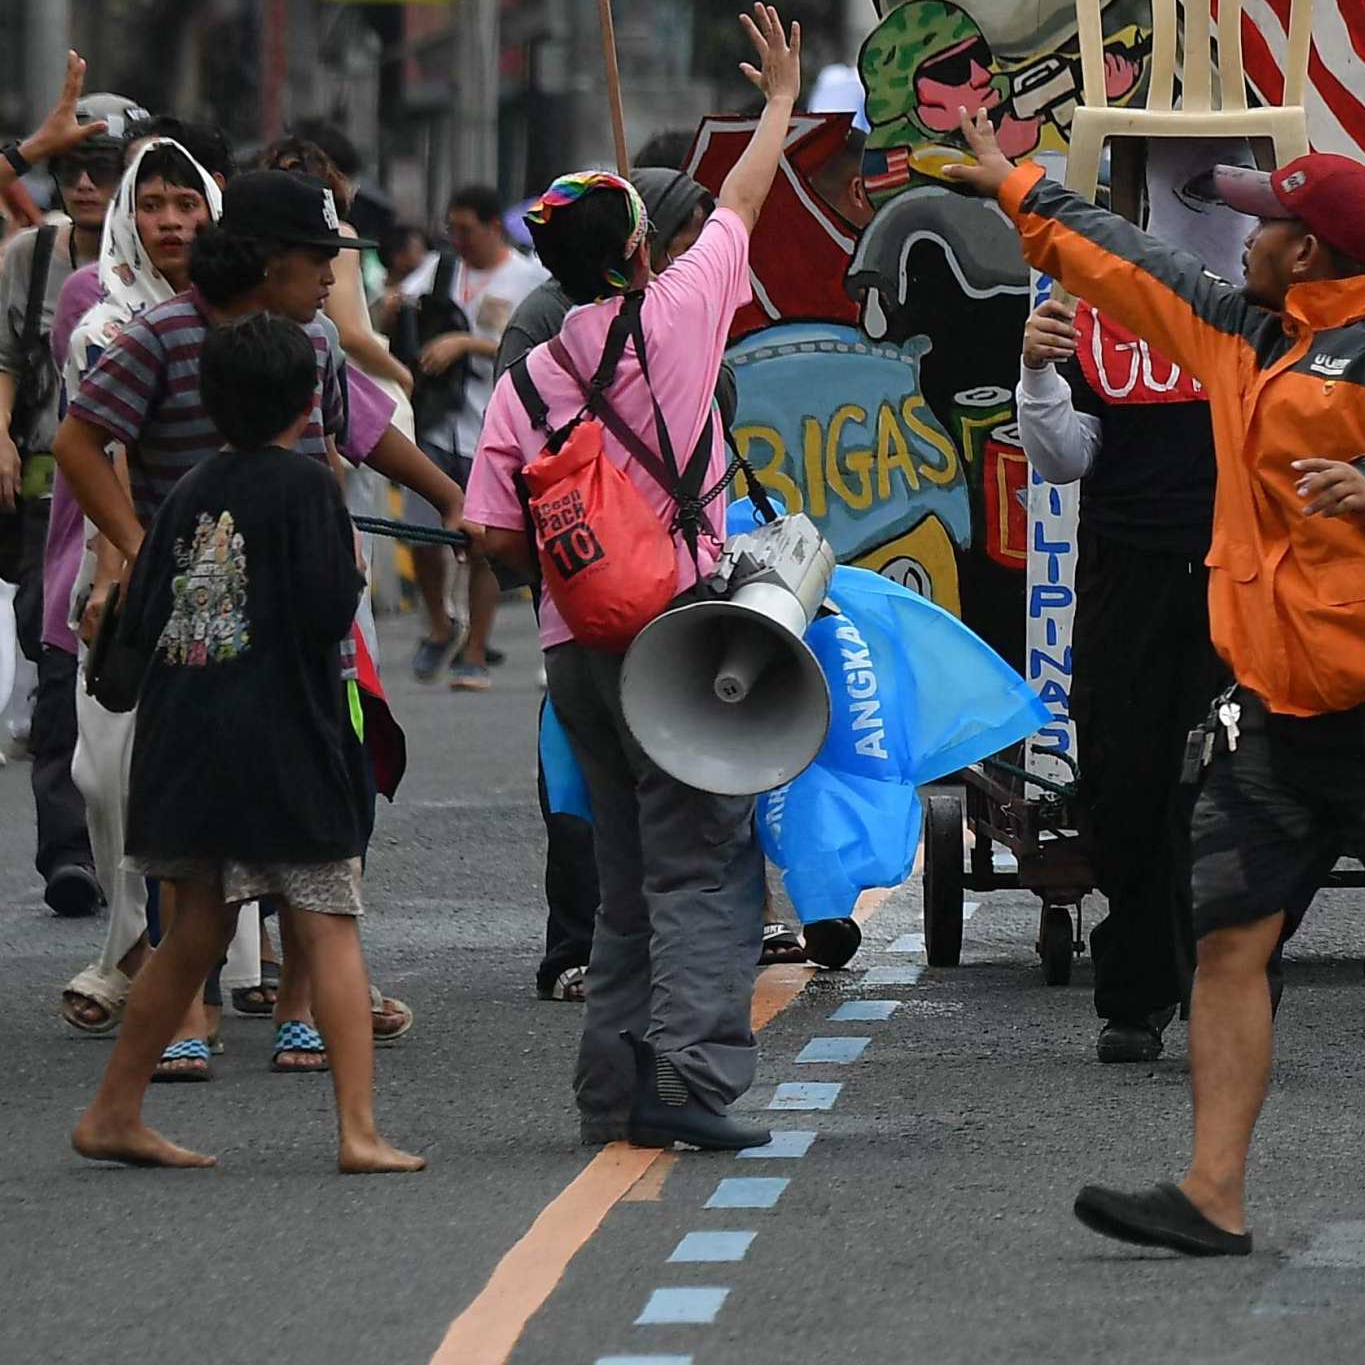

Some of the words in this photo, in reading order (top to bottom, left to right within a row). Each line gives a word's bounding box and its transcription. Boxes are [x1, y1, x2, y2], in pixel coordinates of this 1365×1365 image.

[732, 396, 957, 518] BIGAS
[552, 528, 596, 572] 10
[836, 614, 889, 760] ANGKA
